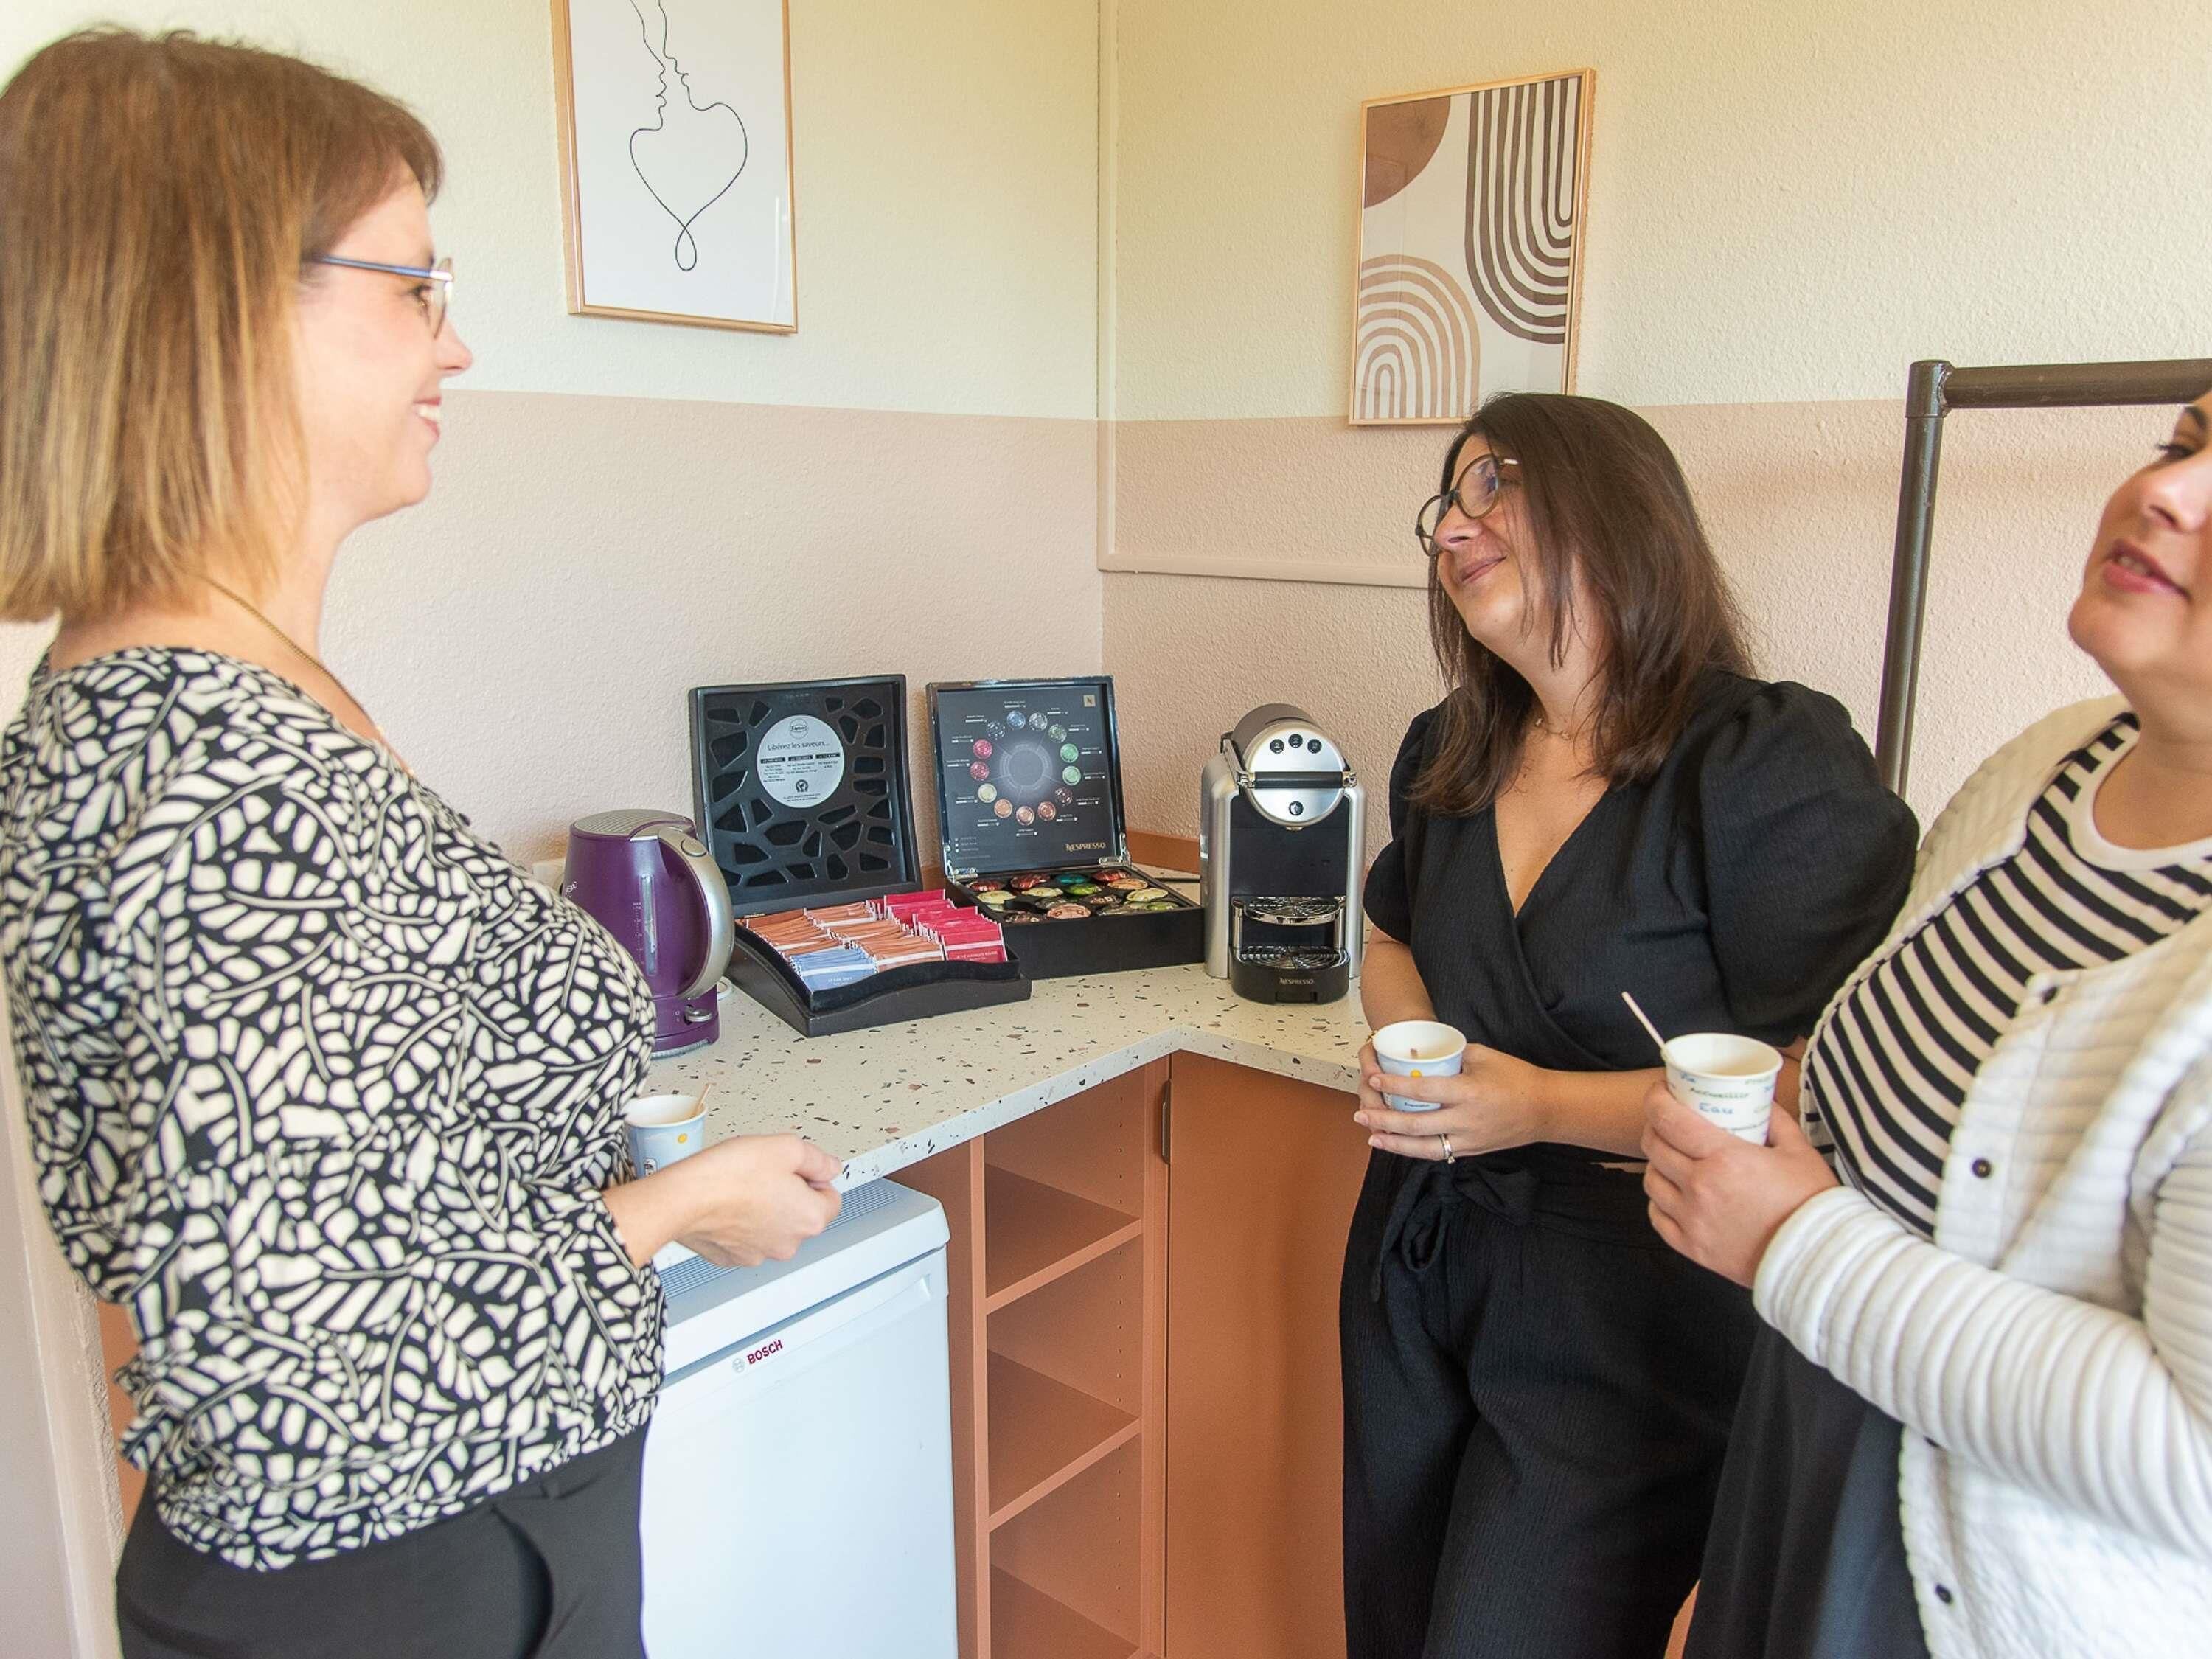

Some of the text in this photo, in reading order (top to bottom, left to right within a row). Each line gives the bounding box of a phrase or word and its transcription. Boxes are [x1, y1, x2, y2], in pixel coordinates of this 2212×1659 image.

[767, 742, 790, 751] Libérez
[1065, 842, 1106, 852] NESPRESSO
[1279, 977, 1314, 986] NESPRESSO
[1699, 1102, 1733, 1114] Eau
[747, 1339, 783, 1365] BOSCH
